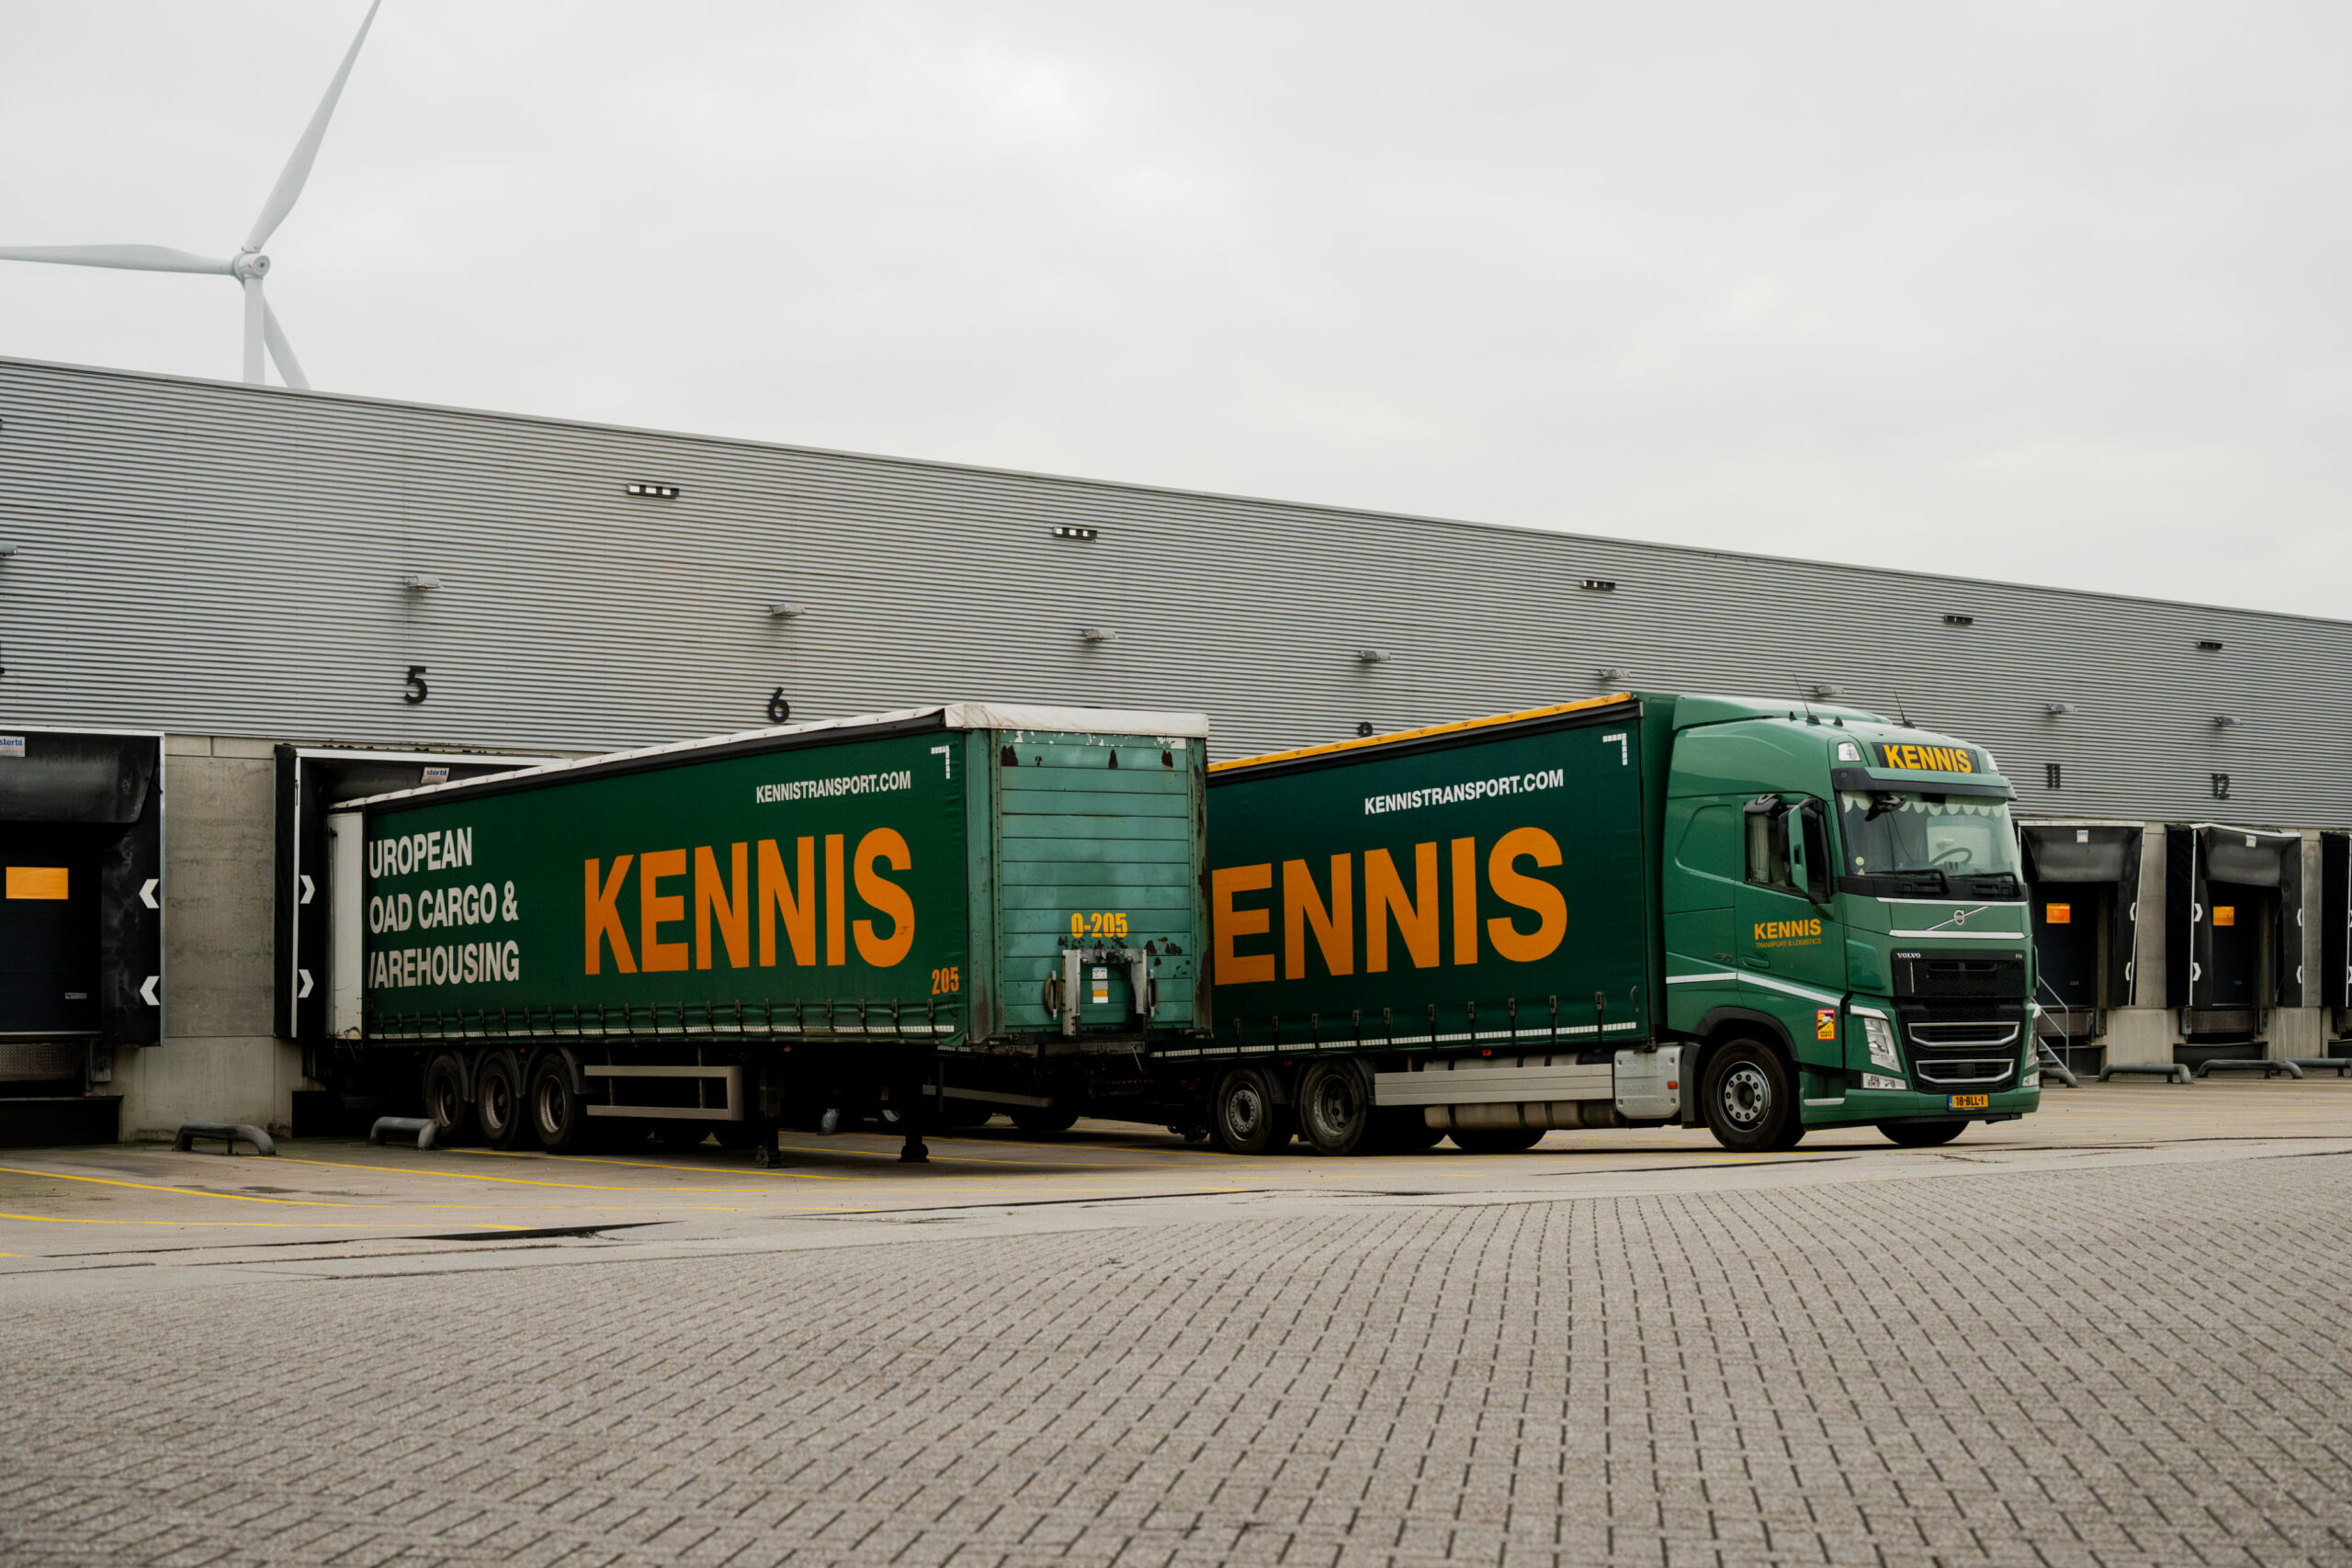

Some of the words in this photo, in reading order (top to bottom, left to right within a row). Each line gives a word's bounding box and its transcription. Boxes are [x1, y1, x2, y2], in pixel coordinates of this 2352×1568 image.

[404, 665, 428, 705] 5
[767, 686, 790, 723] 6
[1883, 744, 1972, 773] KENNIS
[755, 770, 911, 804] KENNISTRANSPORT.COM
[1364, 769, 1564, 815] KENNISTRANSPORT.COM
[2045, 763, 2061, 789] 11
[2211, 773, 2231, 800] 12
[417, 883, 497, 930] CARGO
[502, 880, 519, 922] &
[584, 827, 915, 975] KENNIS
[1212, 827, 1567, 986] ENNIS
[1754, 919, 1822, 940] KENNIS
[1756, 940, 1787, 948] TRANSPORT
[1792, 937, 1822, 946] LOGISTICS
[931, 966, 960, 995] 205
